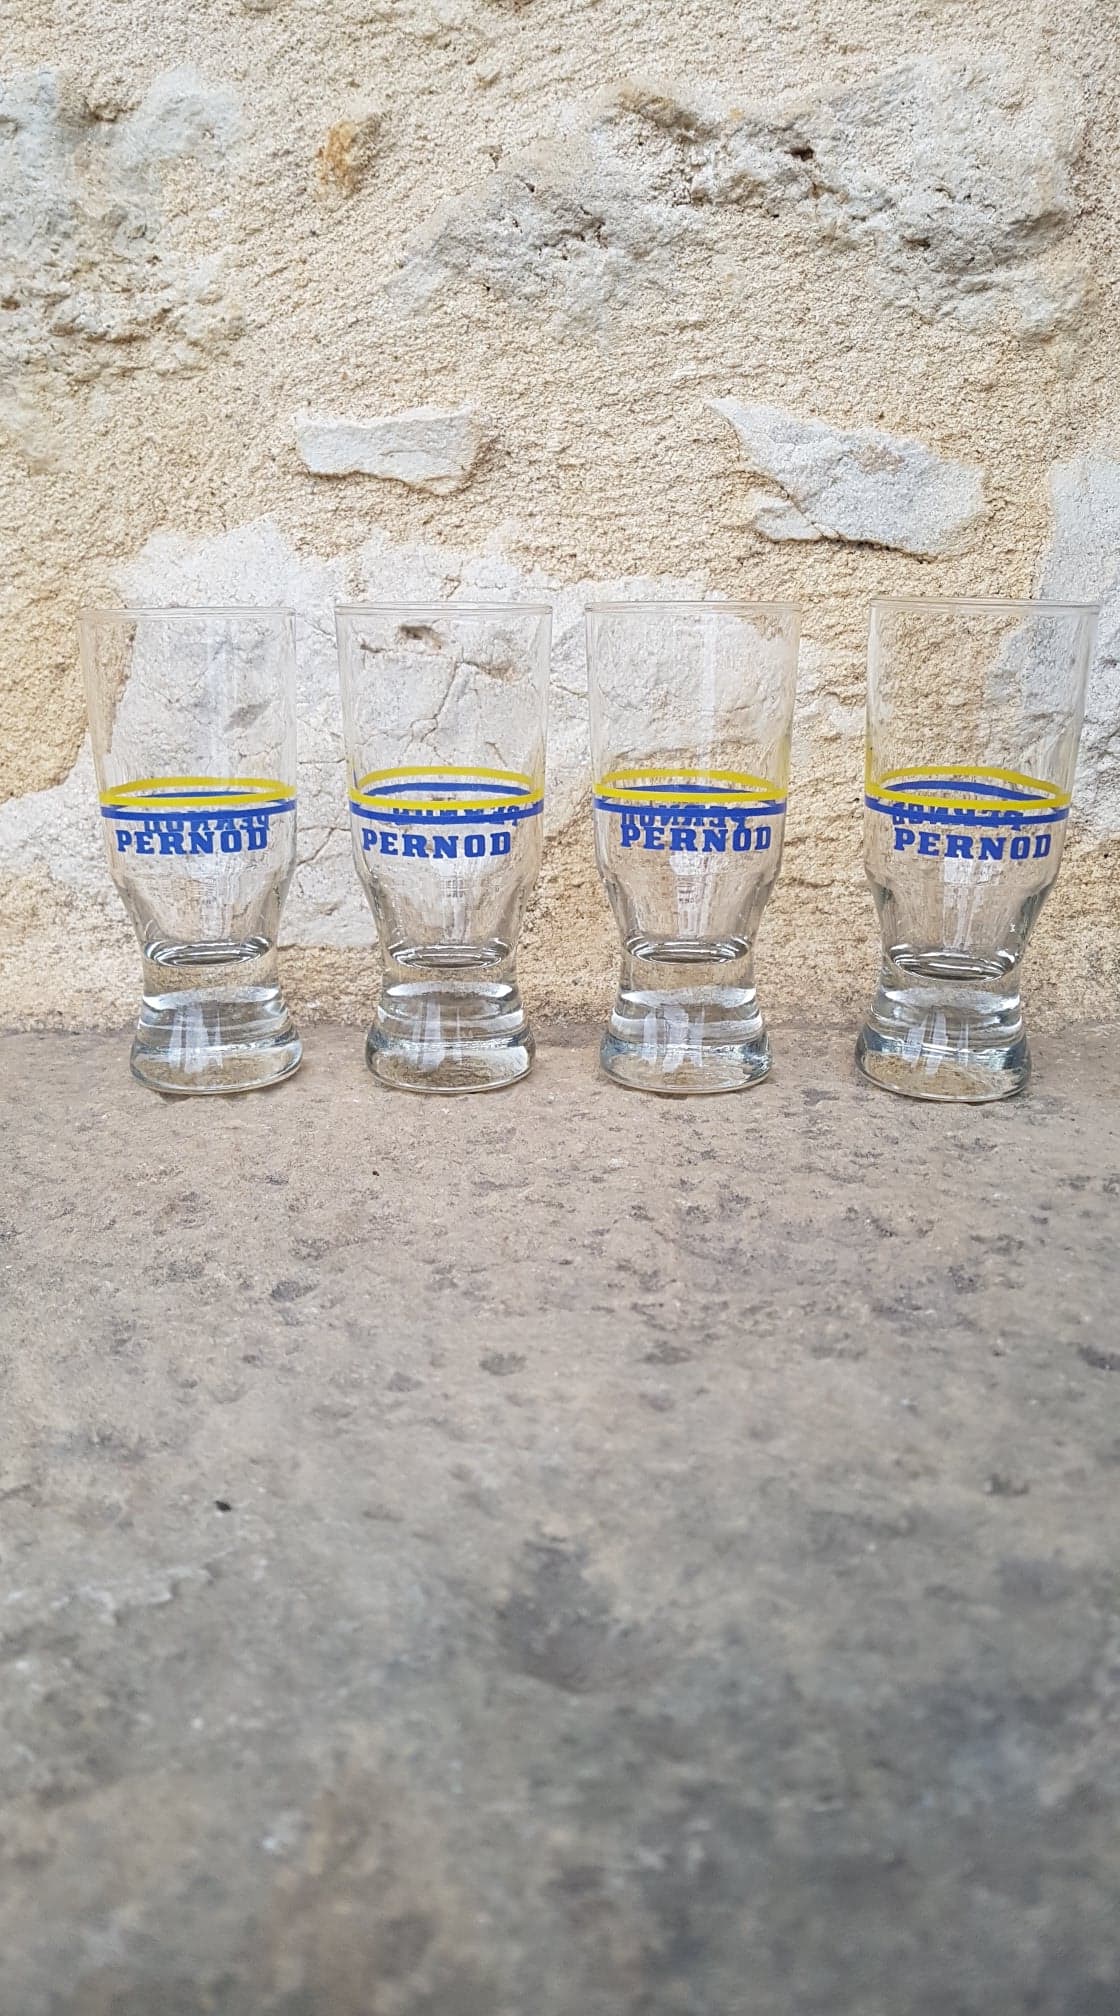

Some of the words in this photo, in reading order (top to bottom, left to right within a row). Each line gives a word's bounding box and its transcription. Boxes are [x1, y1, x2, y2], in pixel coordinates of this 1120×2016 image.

[115, 829, 268, 855] PERNOD
[362, 828, 511, 859] PERNOD
[621, 825, 772, 852] PERNOD
[894, 828, 1051, 860] PERNOD
